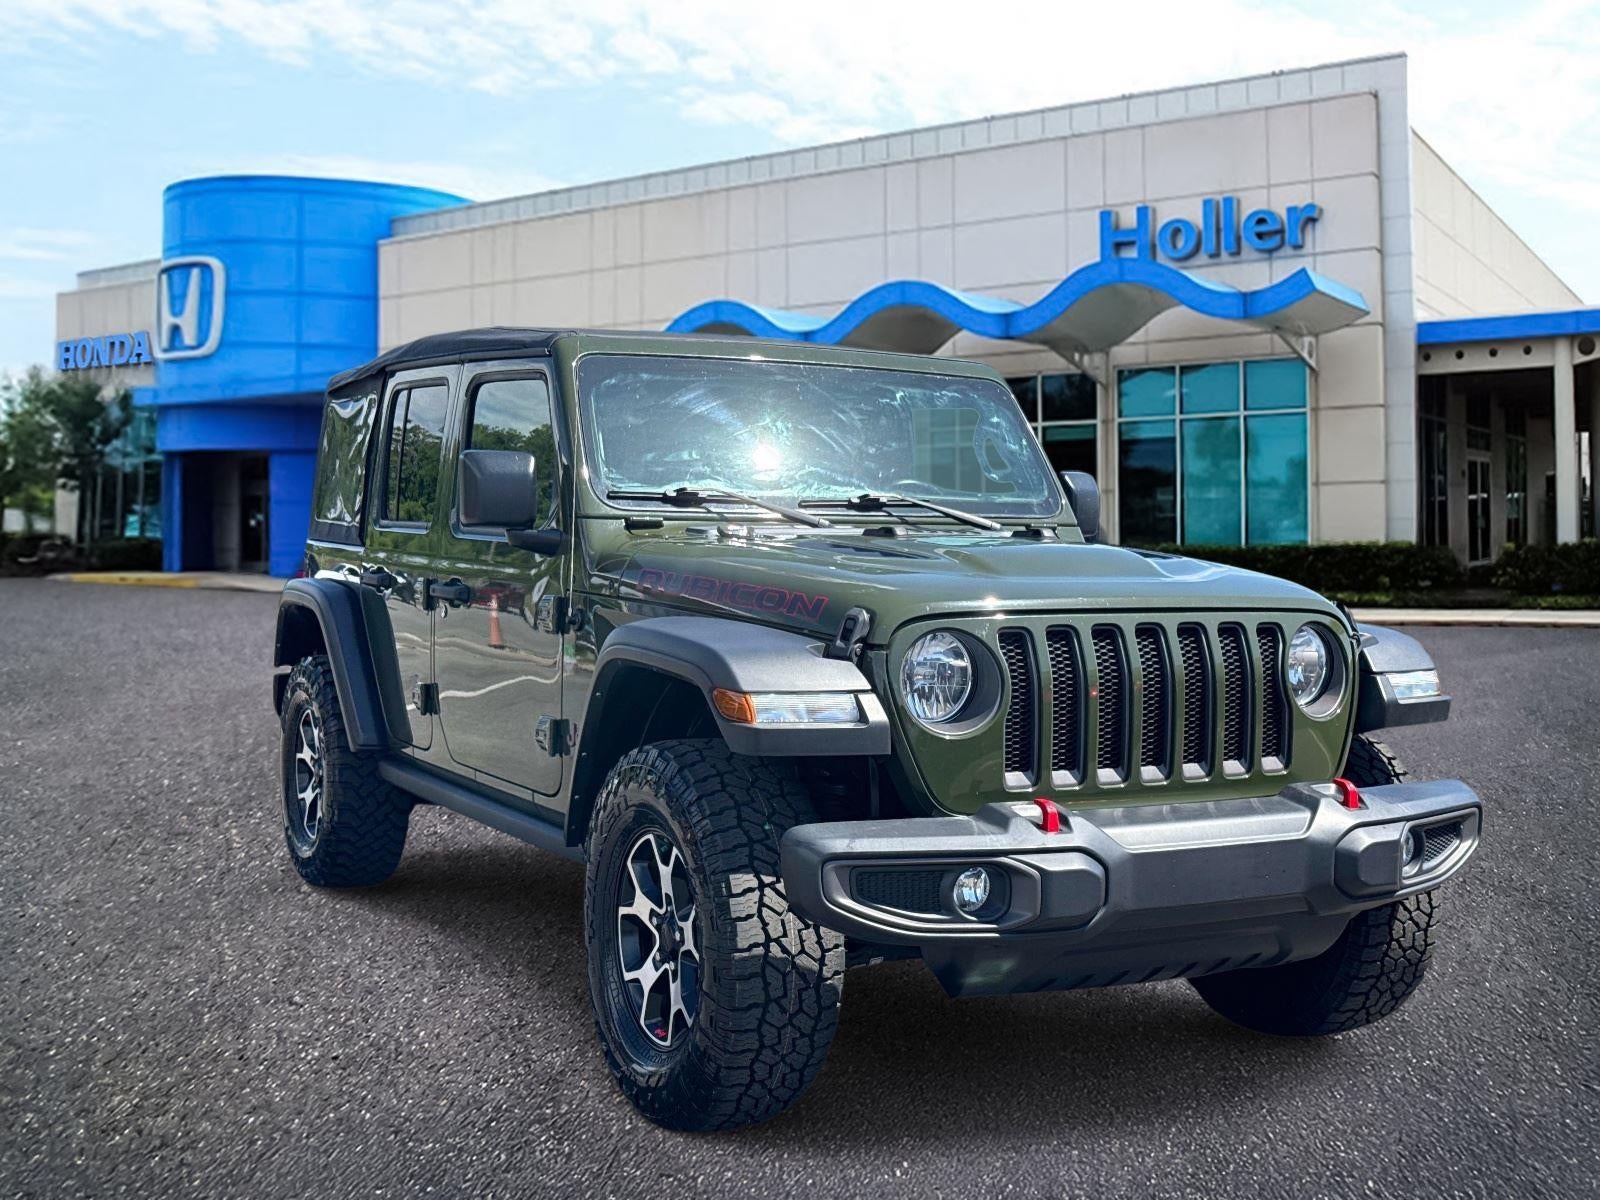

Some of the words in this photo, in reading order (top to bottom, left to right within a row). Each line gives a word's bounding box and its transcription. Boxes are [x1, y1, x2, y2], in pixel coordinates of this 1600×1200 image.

[1100, 196, 1321, 261] Holler
[58, 331, 152, 371] HONDA
[637, 569, 829, 622] RUBICON
